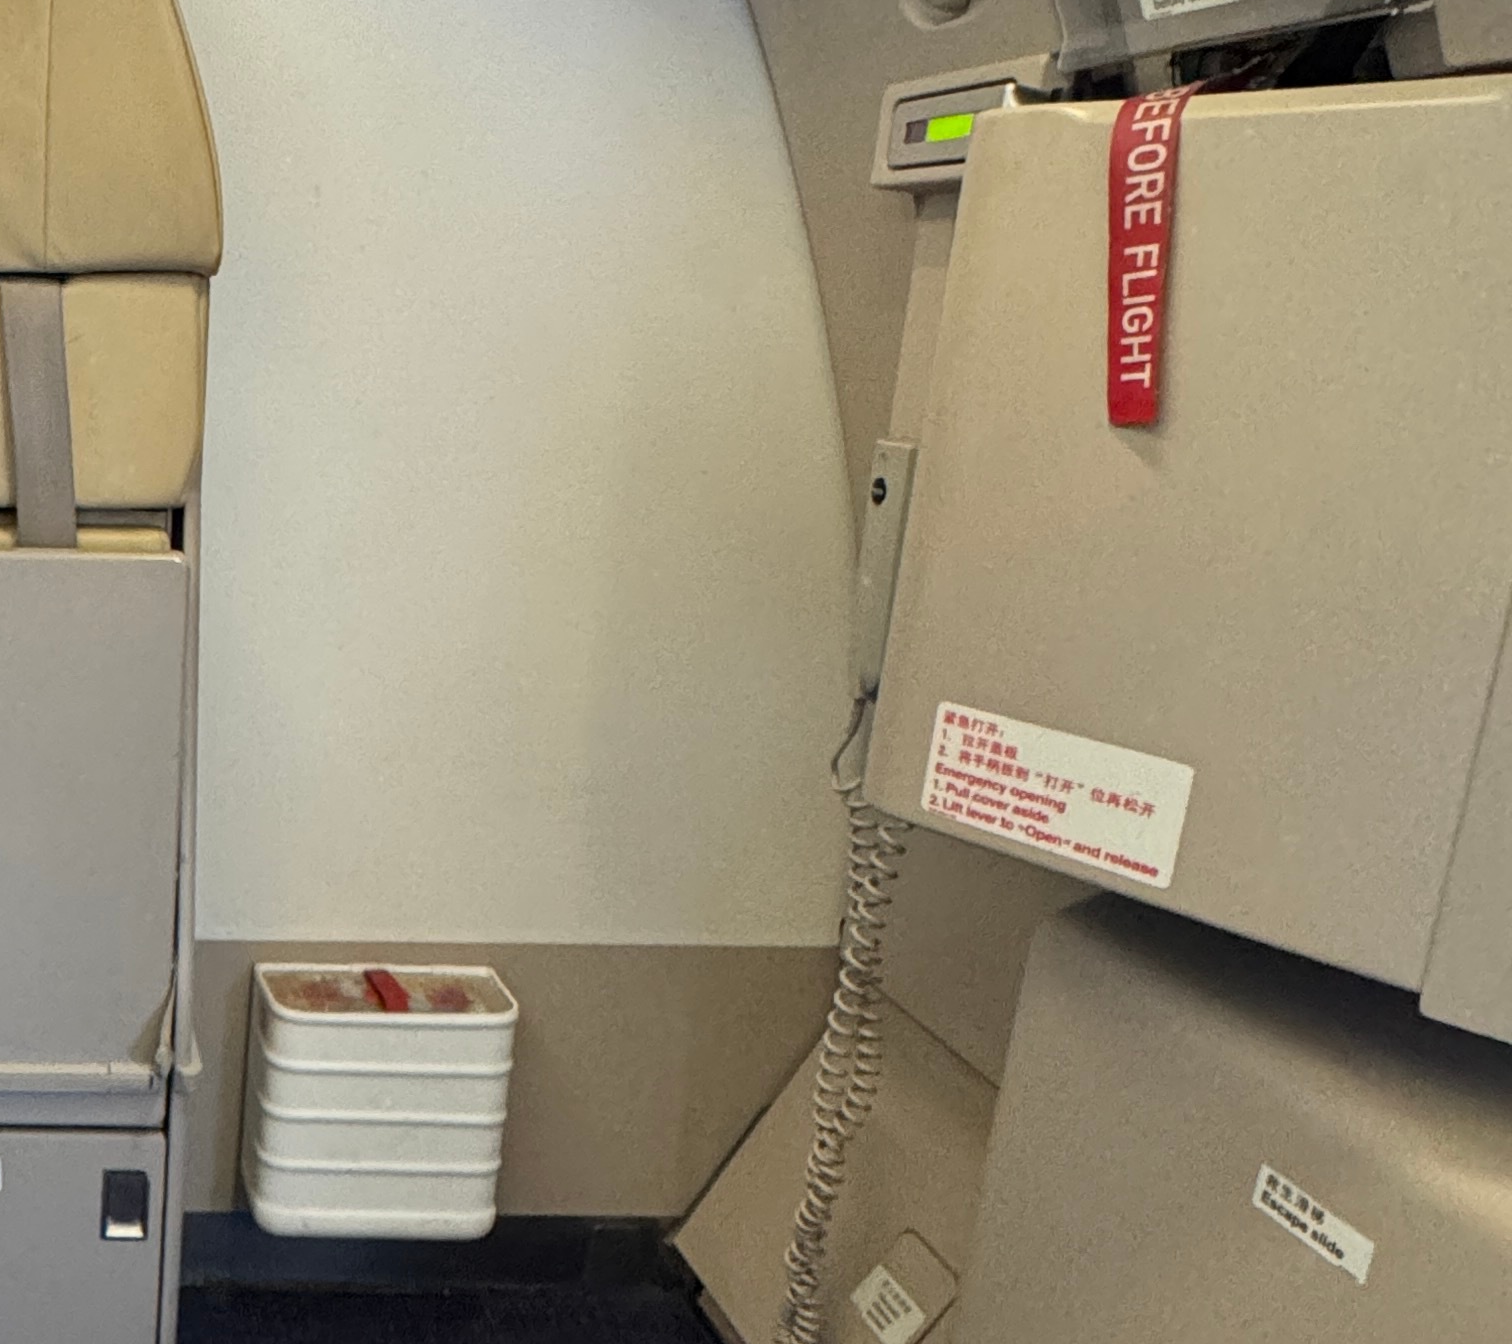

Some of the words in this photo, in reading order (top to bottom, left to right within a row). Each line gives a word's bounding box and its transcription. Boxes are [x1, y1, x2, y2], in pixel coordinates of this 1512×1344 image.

[1120, 242, 1160, 388] FLIGHT
[935, 762, 1007, 795] Emergency
[1009, 786, 1067, 814] opening
[945, 782, 971, 799] Pull
[972, 792, 1010, 811] cover
[1011, 805, 1050, 824] aside
[928, 792, 940, 807] 2.
[942, 797, 964, 814] Lift
[966, 806, 998, 825] lever
[999, 816, 1015, 831] to
[1073, 842, 1102, 860] and
[1104, 851, 1159, 878] release
[1261, 1190, 1308, 1234] Escape
[1310, 1229, 1345, 1260] slide
